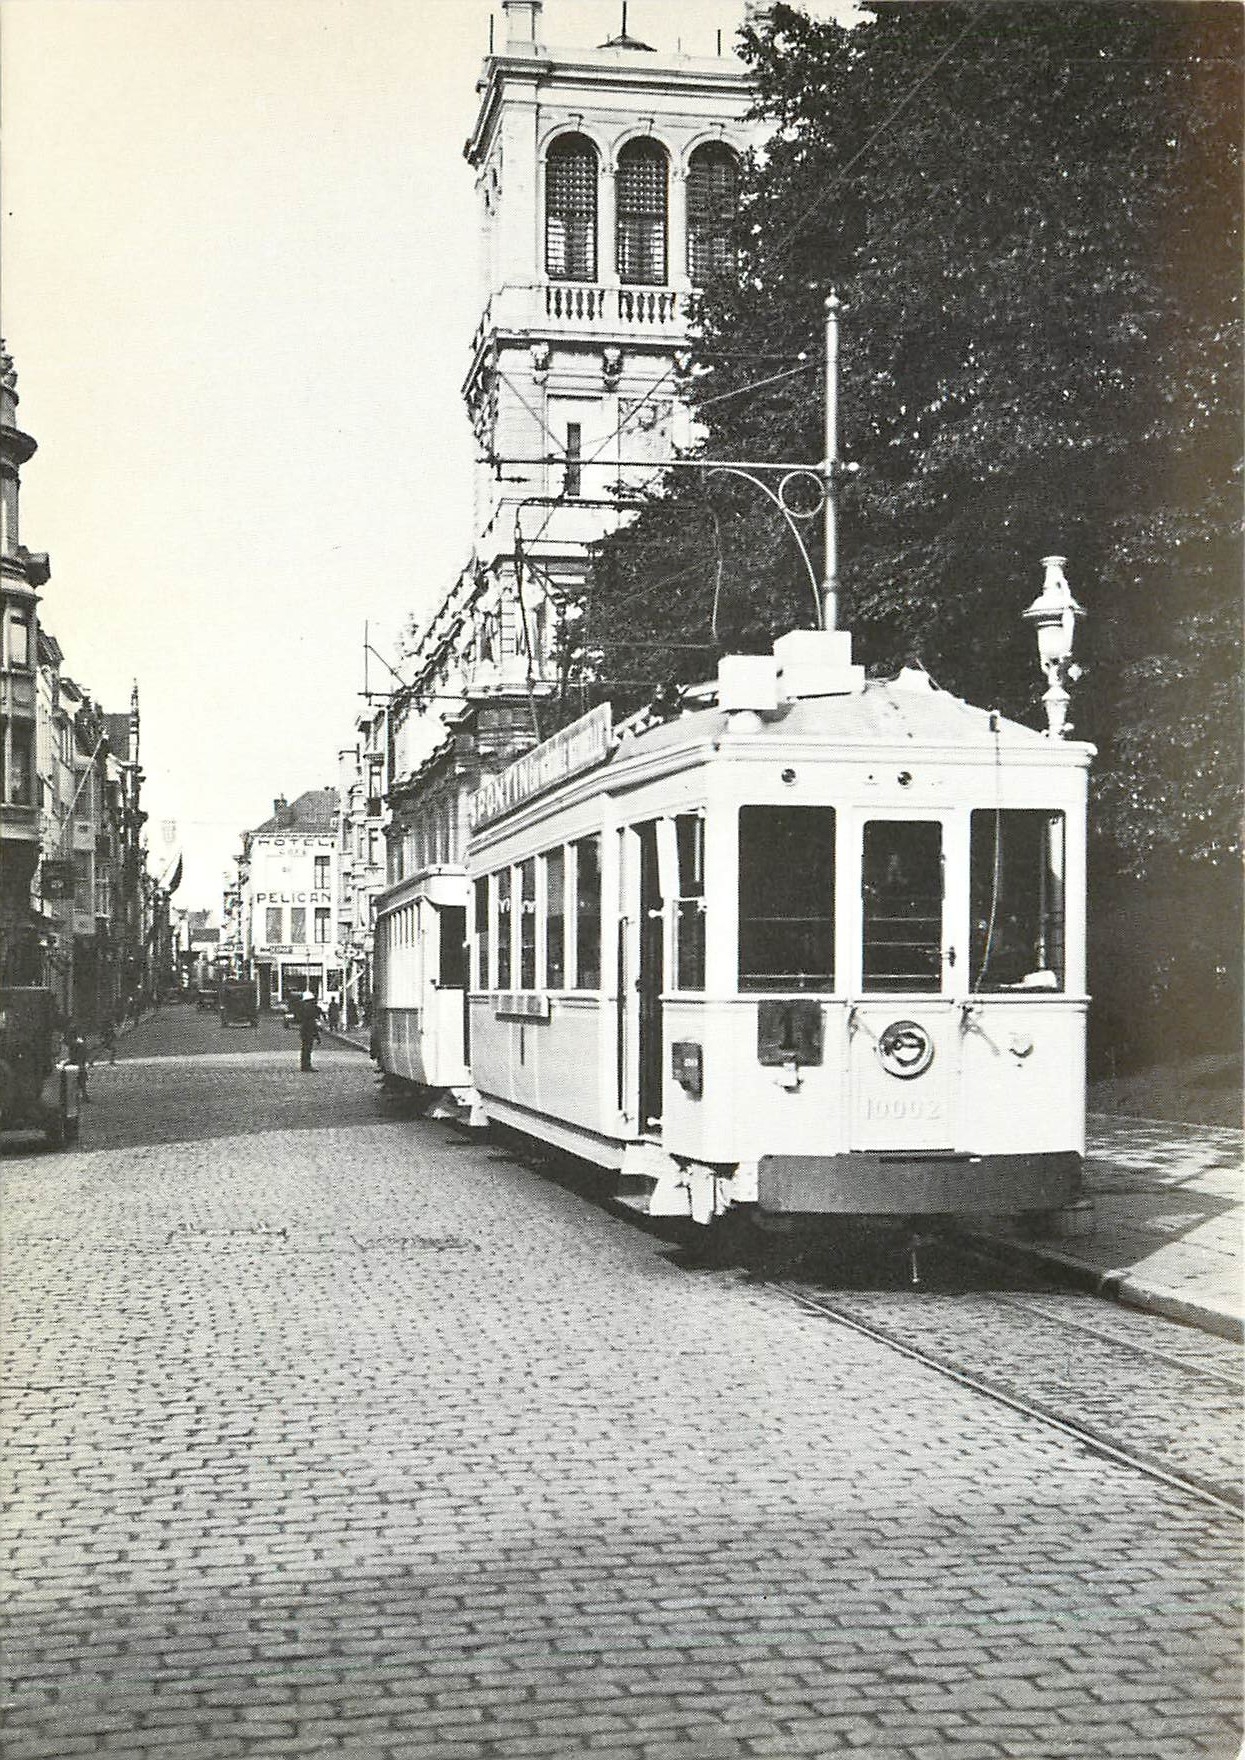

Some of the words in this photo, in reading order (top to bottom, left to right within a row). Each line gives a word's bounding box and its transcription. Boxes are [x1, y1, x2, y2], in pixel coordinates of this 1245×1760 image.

[258, 838, 330, 847] HOTEL
[257, 892, 331, 903] PELICAN
[866, 1097, 941, 1121] 10002
